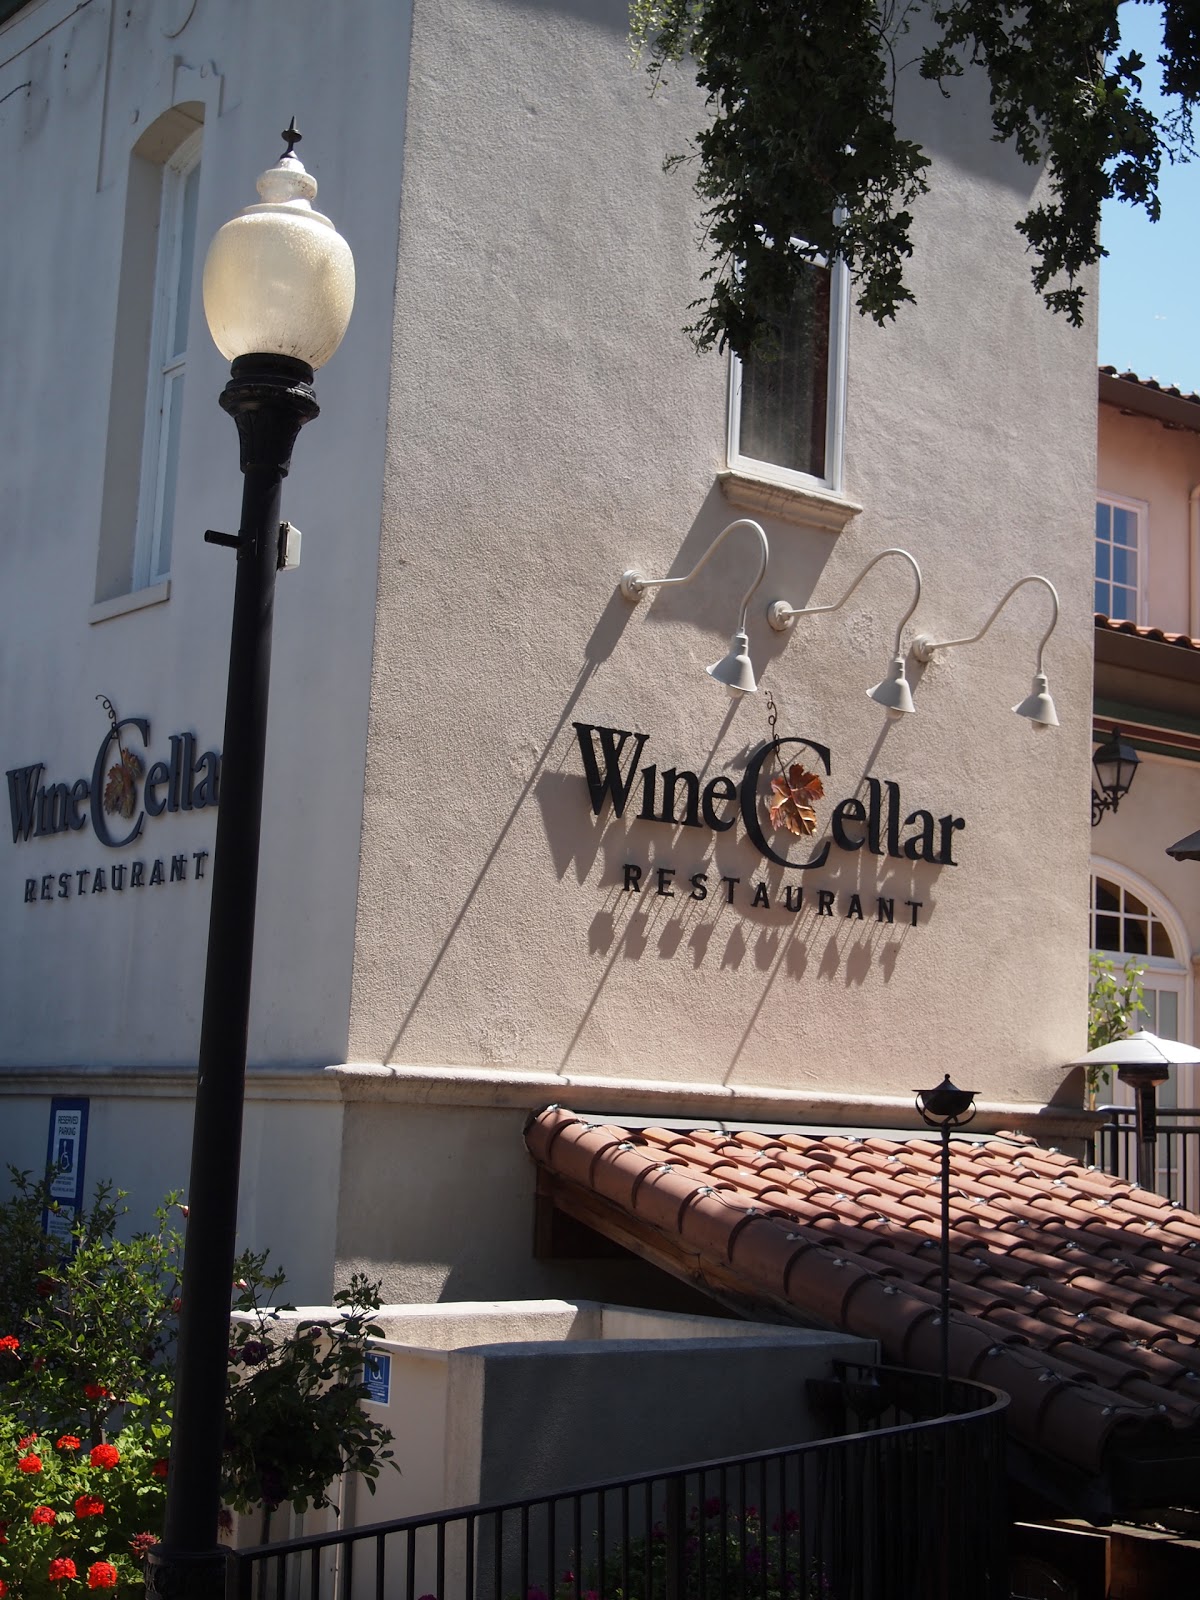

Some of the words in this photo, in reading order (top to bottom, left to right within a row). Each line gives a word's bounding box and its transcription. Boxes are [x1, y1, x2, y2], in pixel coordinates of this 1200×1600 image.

[24, 852, 208, 903] RESTAURANT
[622, 864, 923, 927] RESTAURANT
[58, 1115, 79, 1125] RESERVED
[58, 1126, 77, 1136] PARKING
